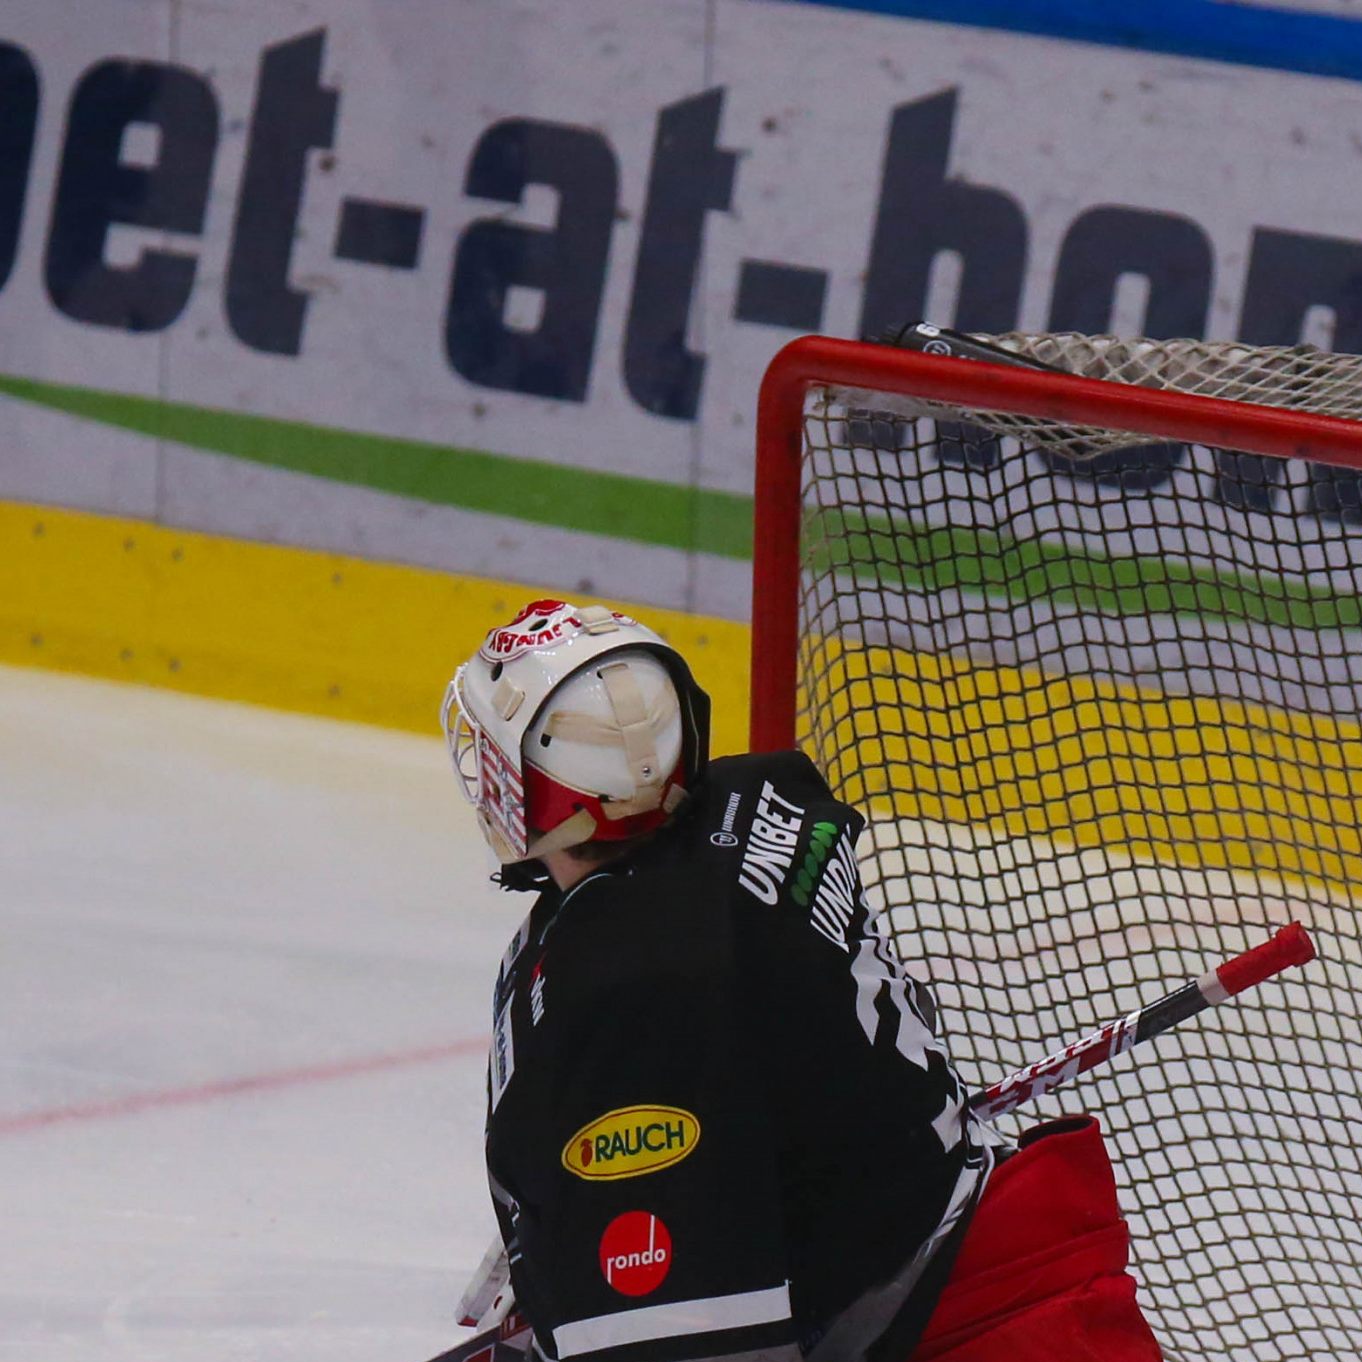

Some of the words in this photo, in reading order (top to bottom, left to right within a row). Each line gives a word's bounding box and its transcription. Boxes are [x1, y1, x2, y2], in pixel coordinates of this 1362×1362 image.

[738, 780, 805, 906] UNIBET
[594, 1120, 684, 1163] RAUCH
[606, 1215, 667, 1285] rondo
